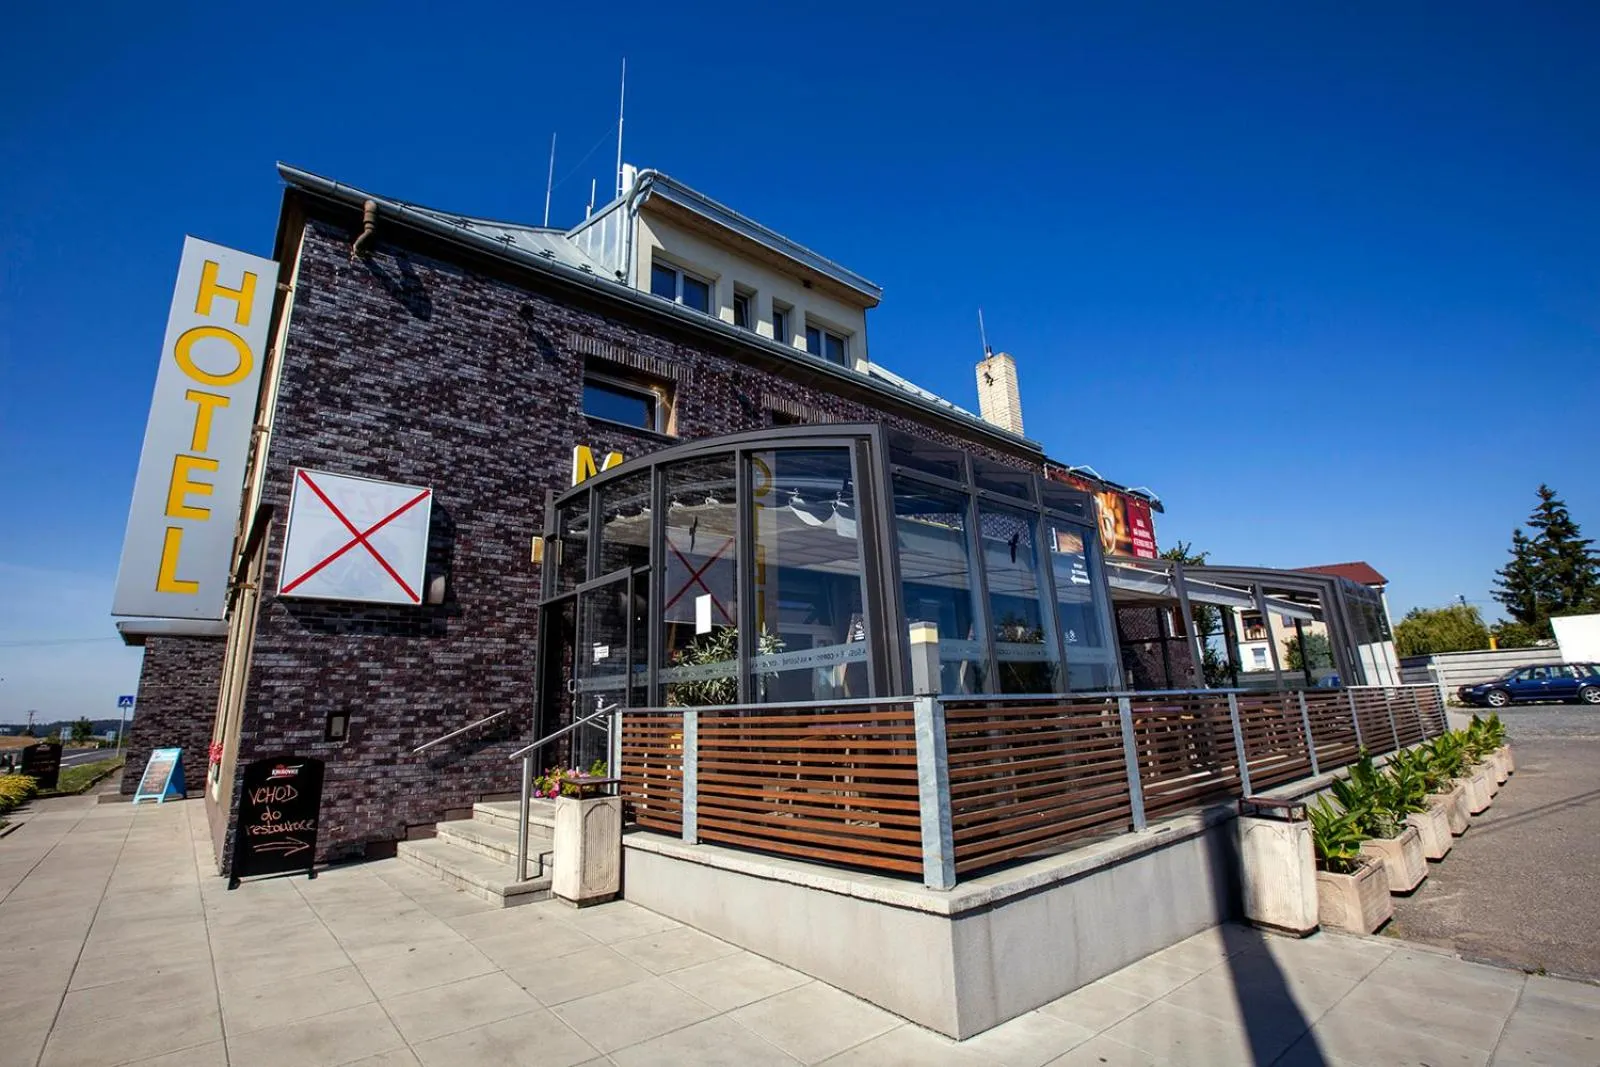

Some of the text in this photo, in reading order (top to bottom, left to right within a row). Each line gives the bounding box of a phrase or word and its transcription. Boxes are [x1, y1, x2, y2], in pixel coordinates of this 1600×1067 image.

[155, 259, 258, 594] HOTEL
[248, 784, 299, 806] VCHOD
[260, 805, 282, 821] do
